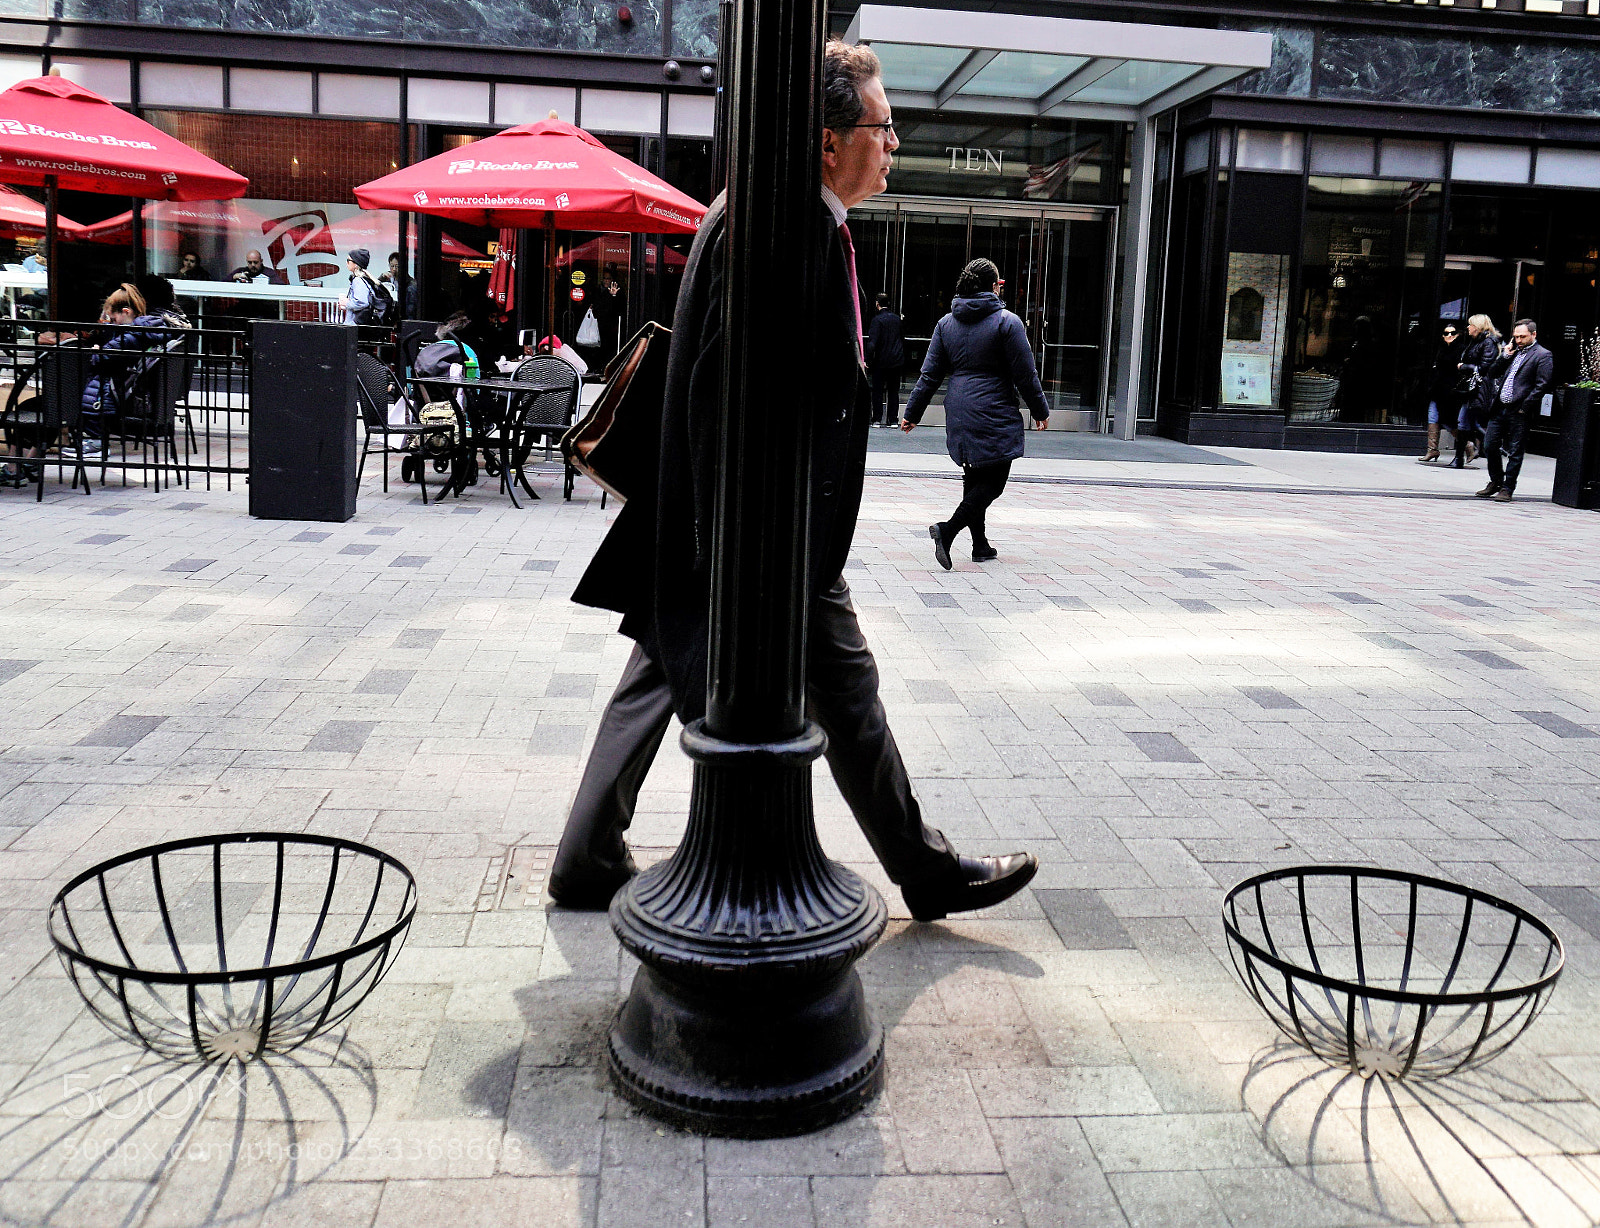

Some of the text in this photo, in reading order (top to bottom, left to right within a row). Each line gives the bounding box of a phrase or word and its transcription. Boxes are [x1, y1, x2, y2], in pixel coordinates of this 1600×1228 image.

[26, 123, 158, 150] Roche Bros.
[15, 156, 147, 181] www.rochebros.com
[474, 160, 579, 171] Roche Bros.
[945, 147, 1004, 173] TEN
[438, 193, 546, 207] www.rochebros.com
